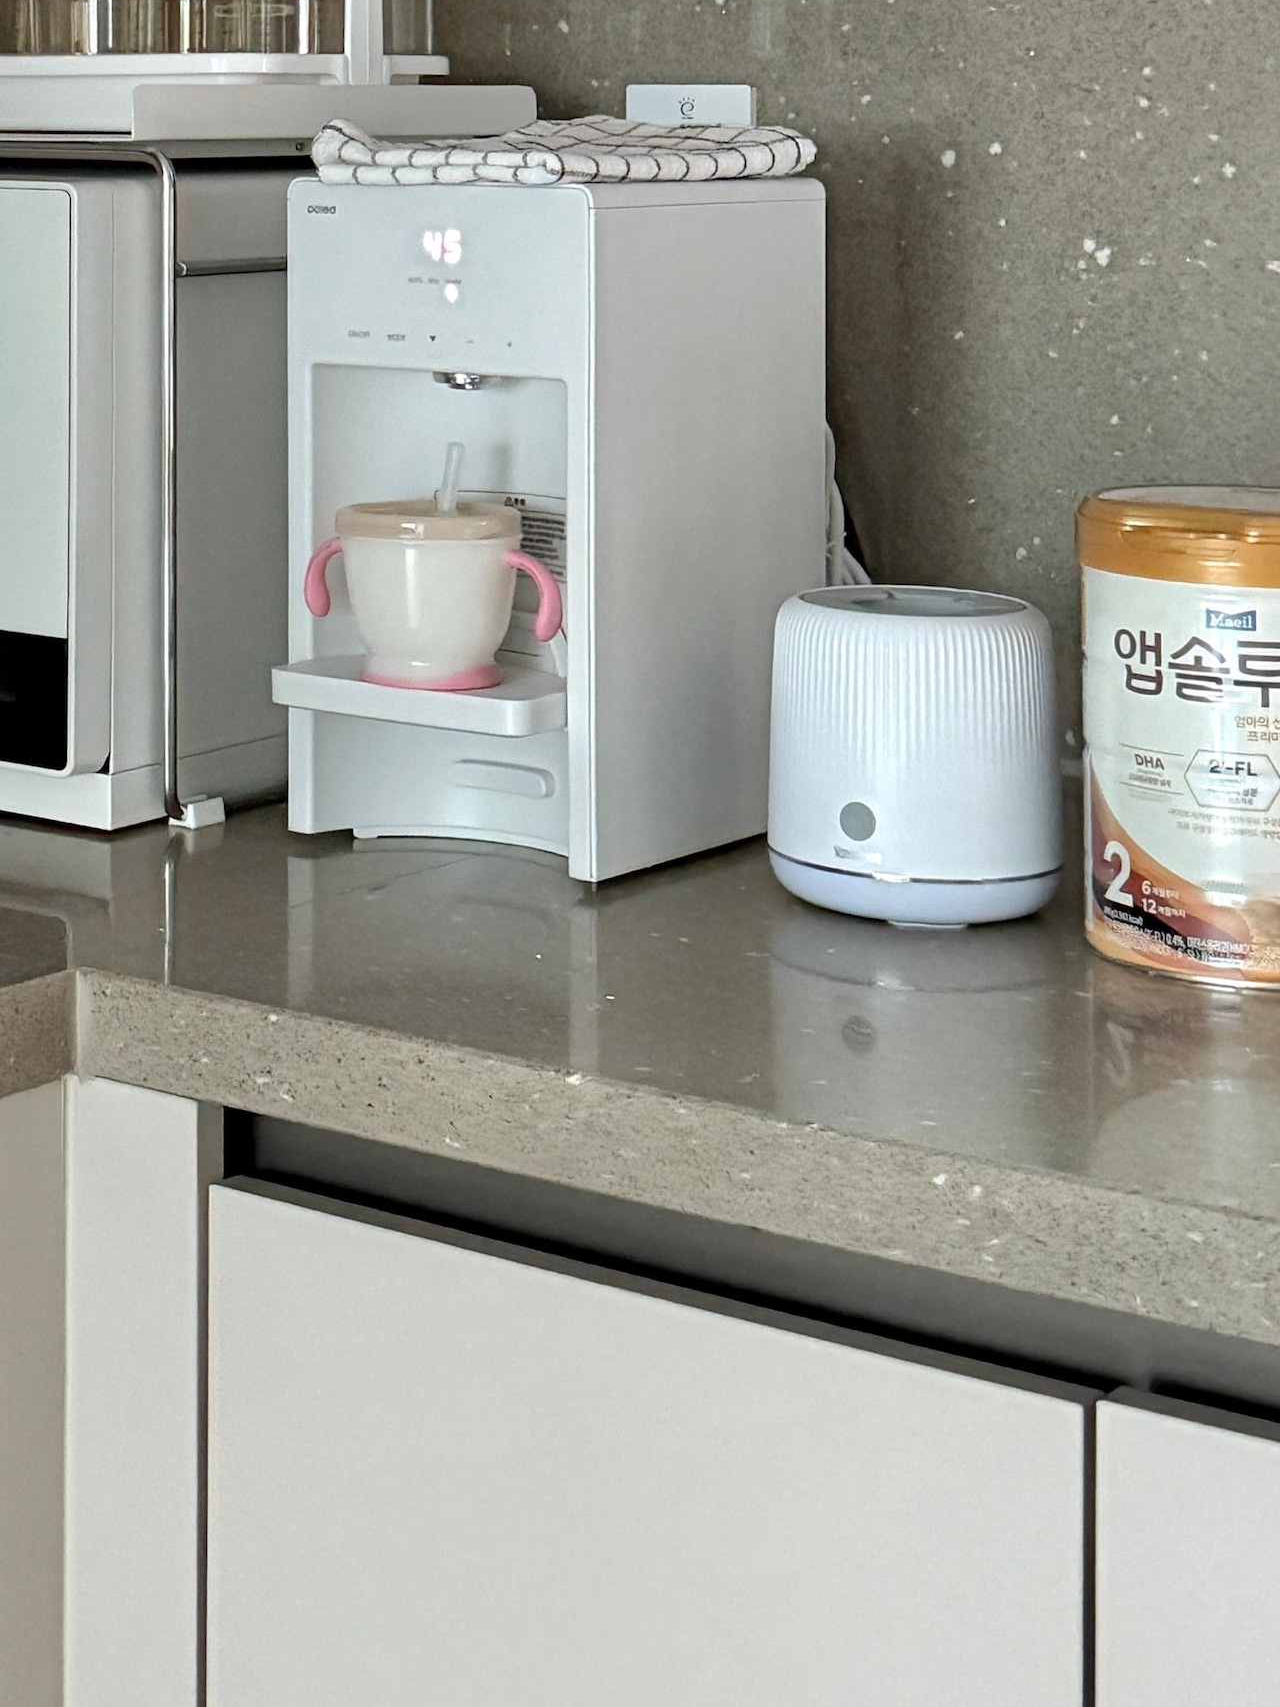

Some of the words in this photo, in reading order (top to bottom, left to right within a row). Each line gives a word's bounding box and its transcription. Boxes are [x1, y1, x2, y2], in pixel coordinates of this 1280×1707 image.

[422, 228, 462, 265] 45
[1210, 613, 1253, 629] Maeil
[1135, 754, 1165, 771] DHA
[1103, 840, 1134, 908] 2
